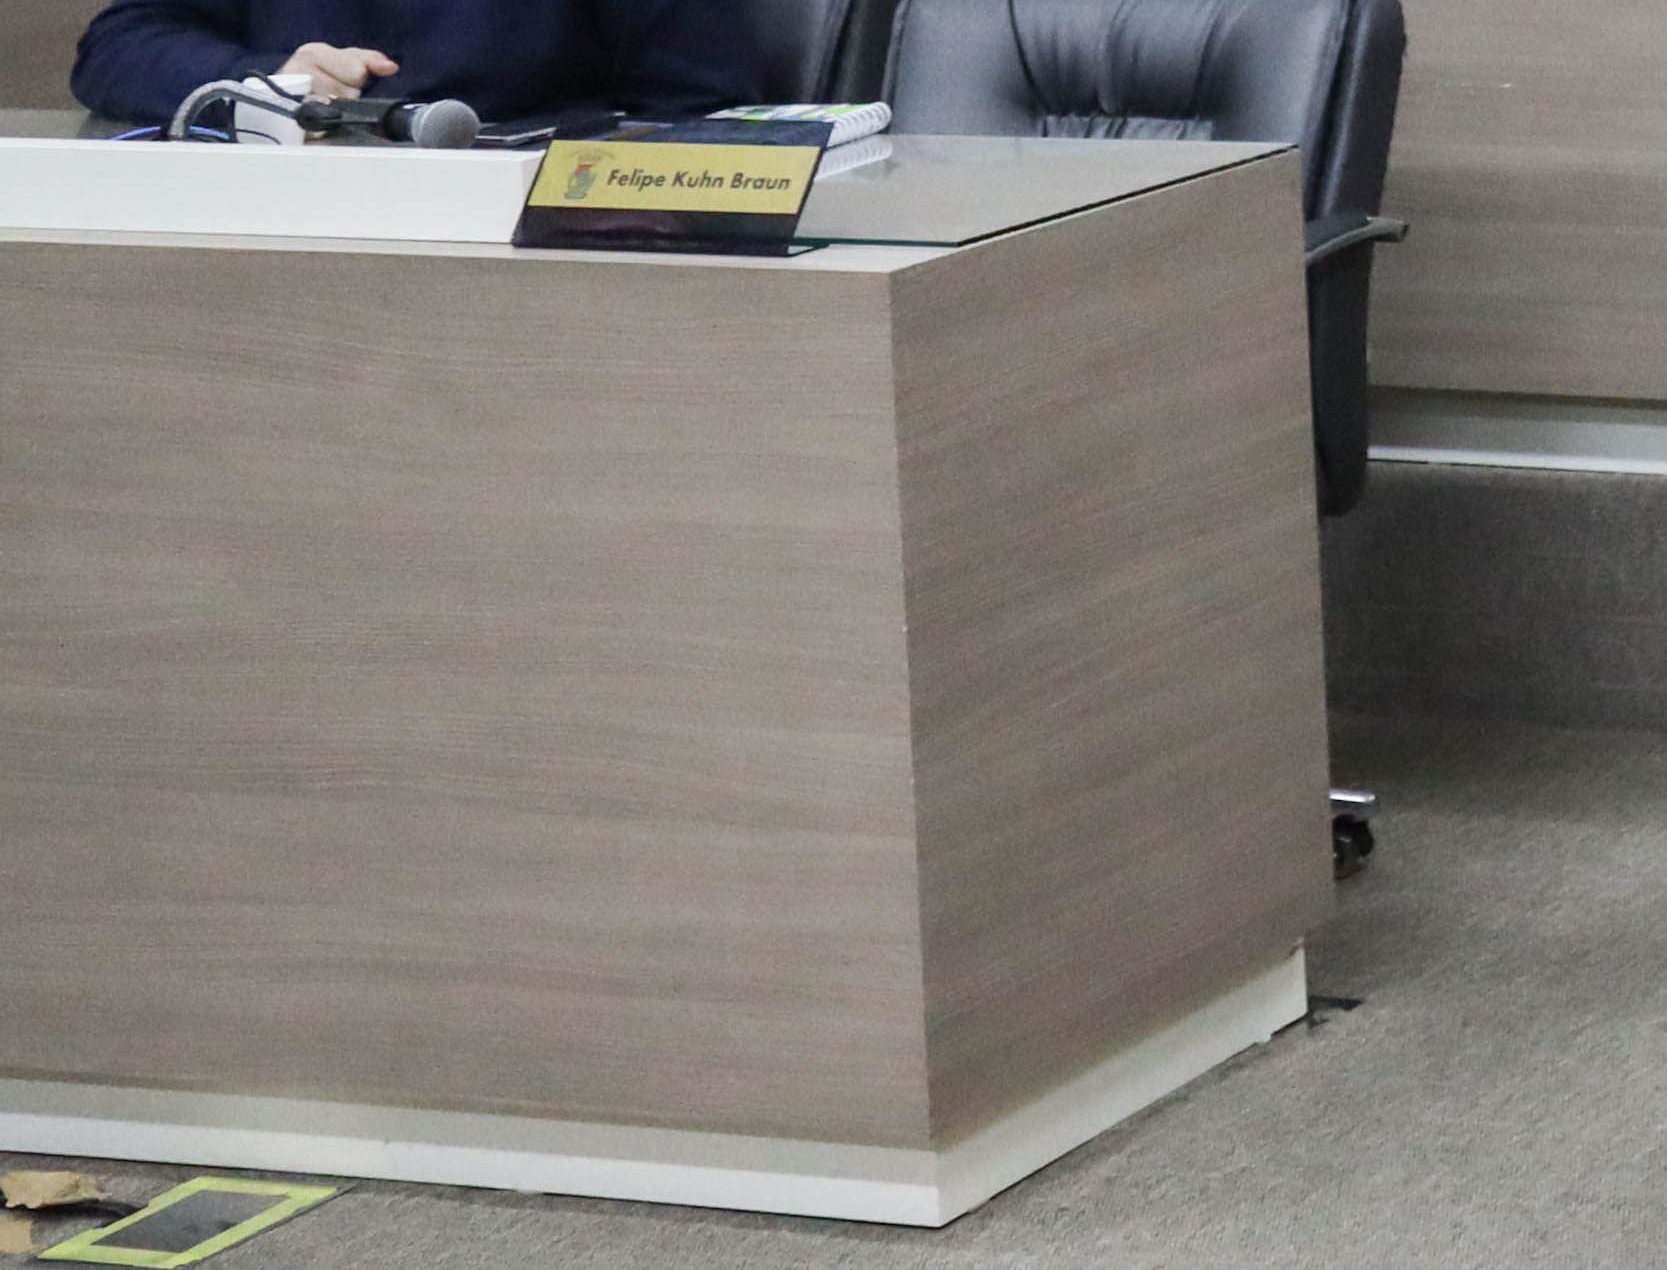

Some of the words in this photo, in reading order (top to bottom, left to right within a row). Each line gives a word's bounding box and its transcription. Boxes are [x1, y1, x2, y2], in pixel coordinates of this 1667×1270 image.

[607, 169, 665, 192] Felipe
[671, 171, 724, 189] Kuhn
[730, 172, 791, 191] Braun
